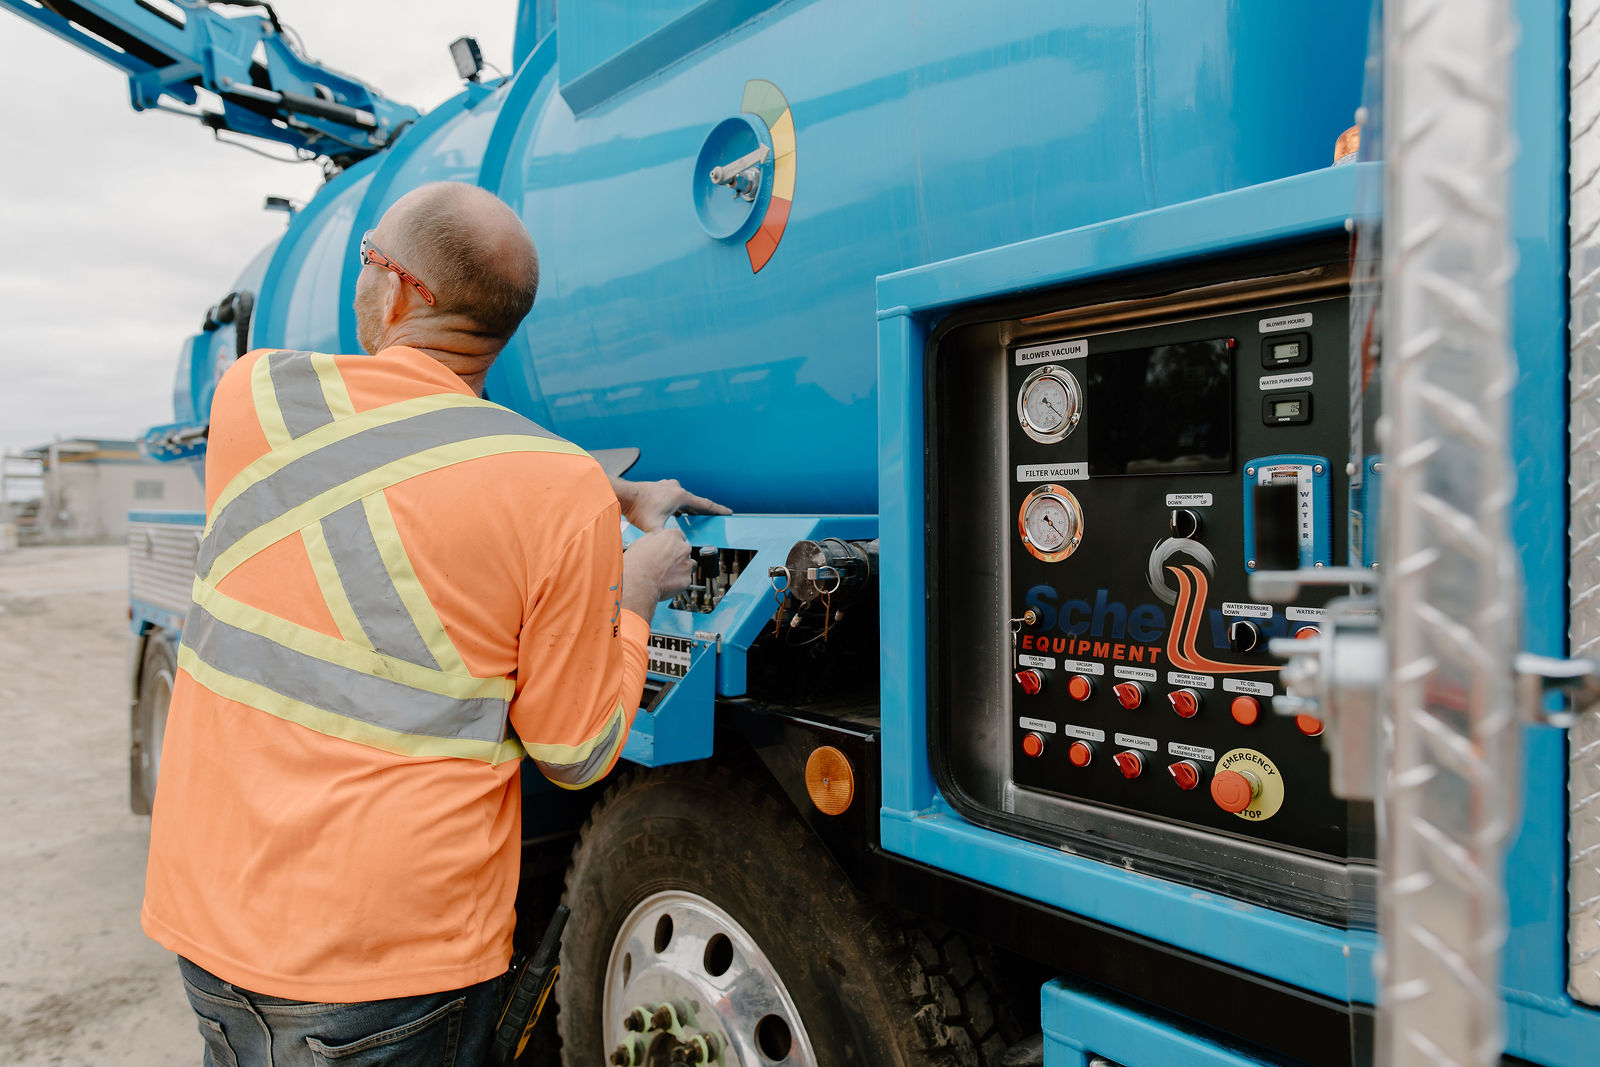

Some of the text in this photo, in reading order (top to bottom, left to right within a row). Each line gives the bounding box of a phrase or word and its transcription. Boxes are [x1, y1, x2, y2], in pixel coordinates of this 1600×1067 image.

[1266, 317, 1306, 328] BLOWER HOURS
[1021, 346, 1081, 360] BLOWER VACUUM
[1299, 491, 1310, 539] WATER
[1022, 635, 1162, 664] EQUIPMENT
[1117, 668, 1135, 676] CABINET
[1170, 749, 1200, 758] PASSENGER'S
[1222, 752, 1276, 776] EMERGENCY
